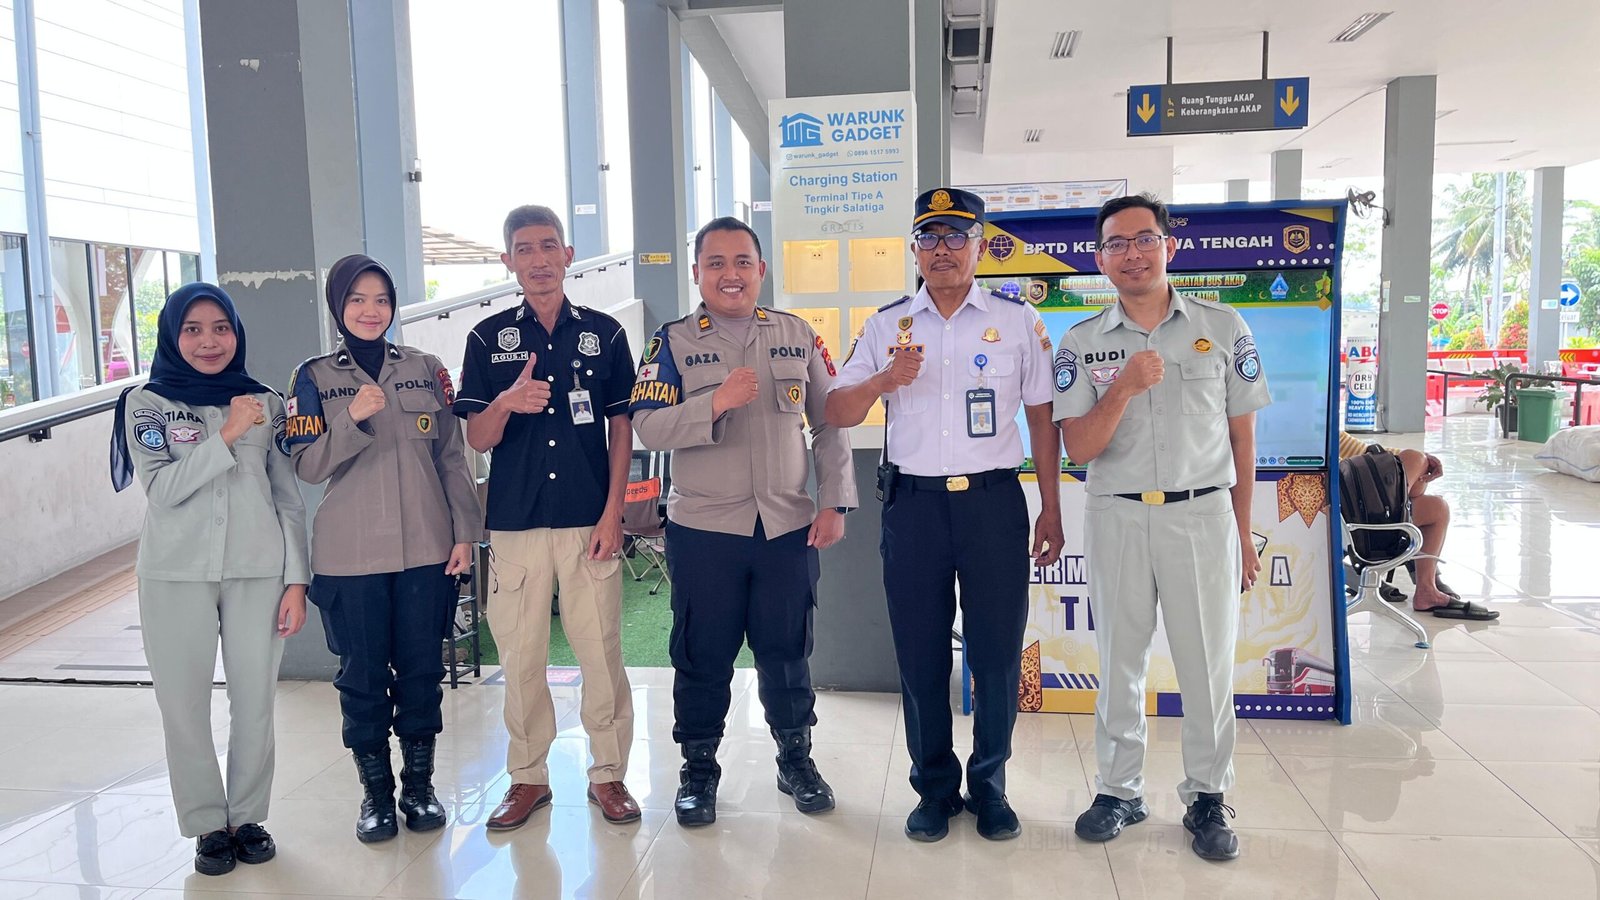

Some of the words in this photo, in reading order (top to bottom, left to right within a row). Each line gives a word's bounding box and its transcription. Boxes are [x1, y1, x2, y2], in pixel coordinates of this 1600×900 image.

[1181, 96, 1204, 106] Ruang
[1205, 95, 1232, 105] Tunggu
[1233, 93, 1255, 102] AKAP
[1180, 106, 1239, 117] Keberangkatan
[1240, 104, 1262, 113] AKAP
[827, 109, 905, 127] WARUNK
[831, 126, 902, 142] GADGET
[793, 151, 839, 160] warunk_gadget
[789, 173, 848, 188] Charging
[852, 171, 898, 184] Station
[804, 193, 848, 203] Terminal
[851, 191, 873, 201] Tipe
[875, 190, 884, 200] A
[804, 204, 841, 216] Tingkir
[843, 202, 884, 214] Salatiga
[1023, 242, 1068, 255] BPTD
[1073, 241, 1097, 253] KE
[1199, 235, 1273, 250] TENGAH
[1168, 275, 1204, 287] NGKATAN
[1207, 275, 1222, 286] BUS
[1224, 273, 1245, 286] AKAP
[1085, 293, 1118, 304] TERMINA
[770, 346, 806, 359] POLRI
[1084, 349, 1126, 364] BUDI
[685, 353, 720, 366] GAZA
[395, 379, 434, 391] POLRI
[1353, 383, 1373, 391] CELL
[165, 410, 204, 424] TIARA
[1270, 555, 1292, 586] A
